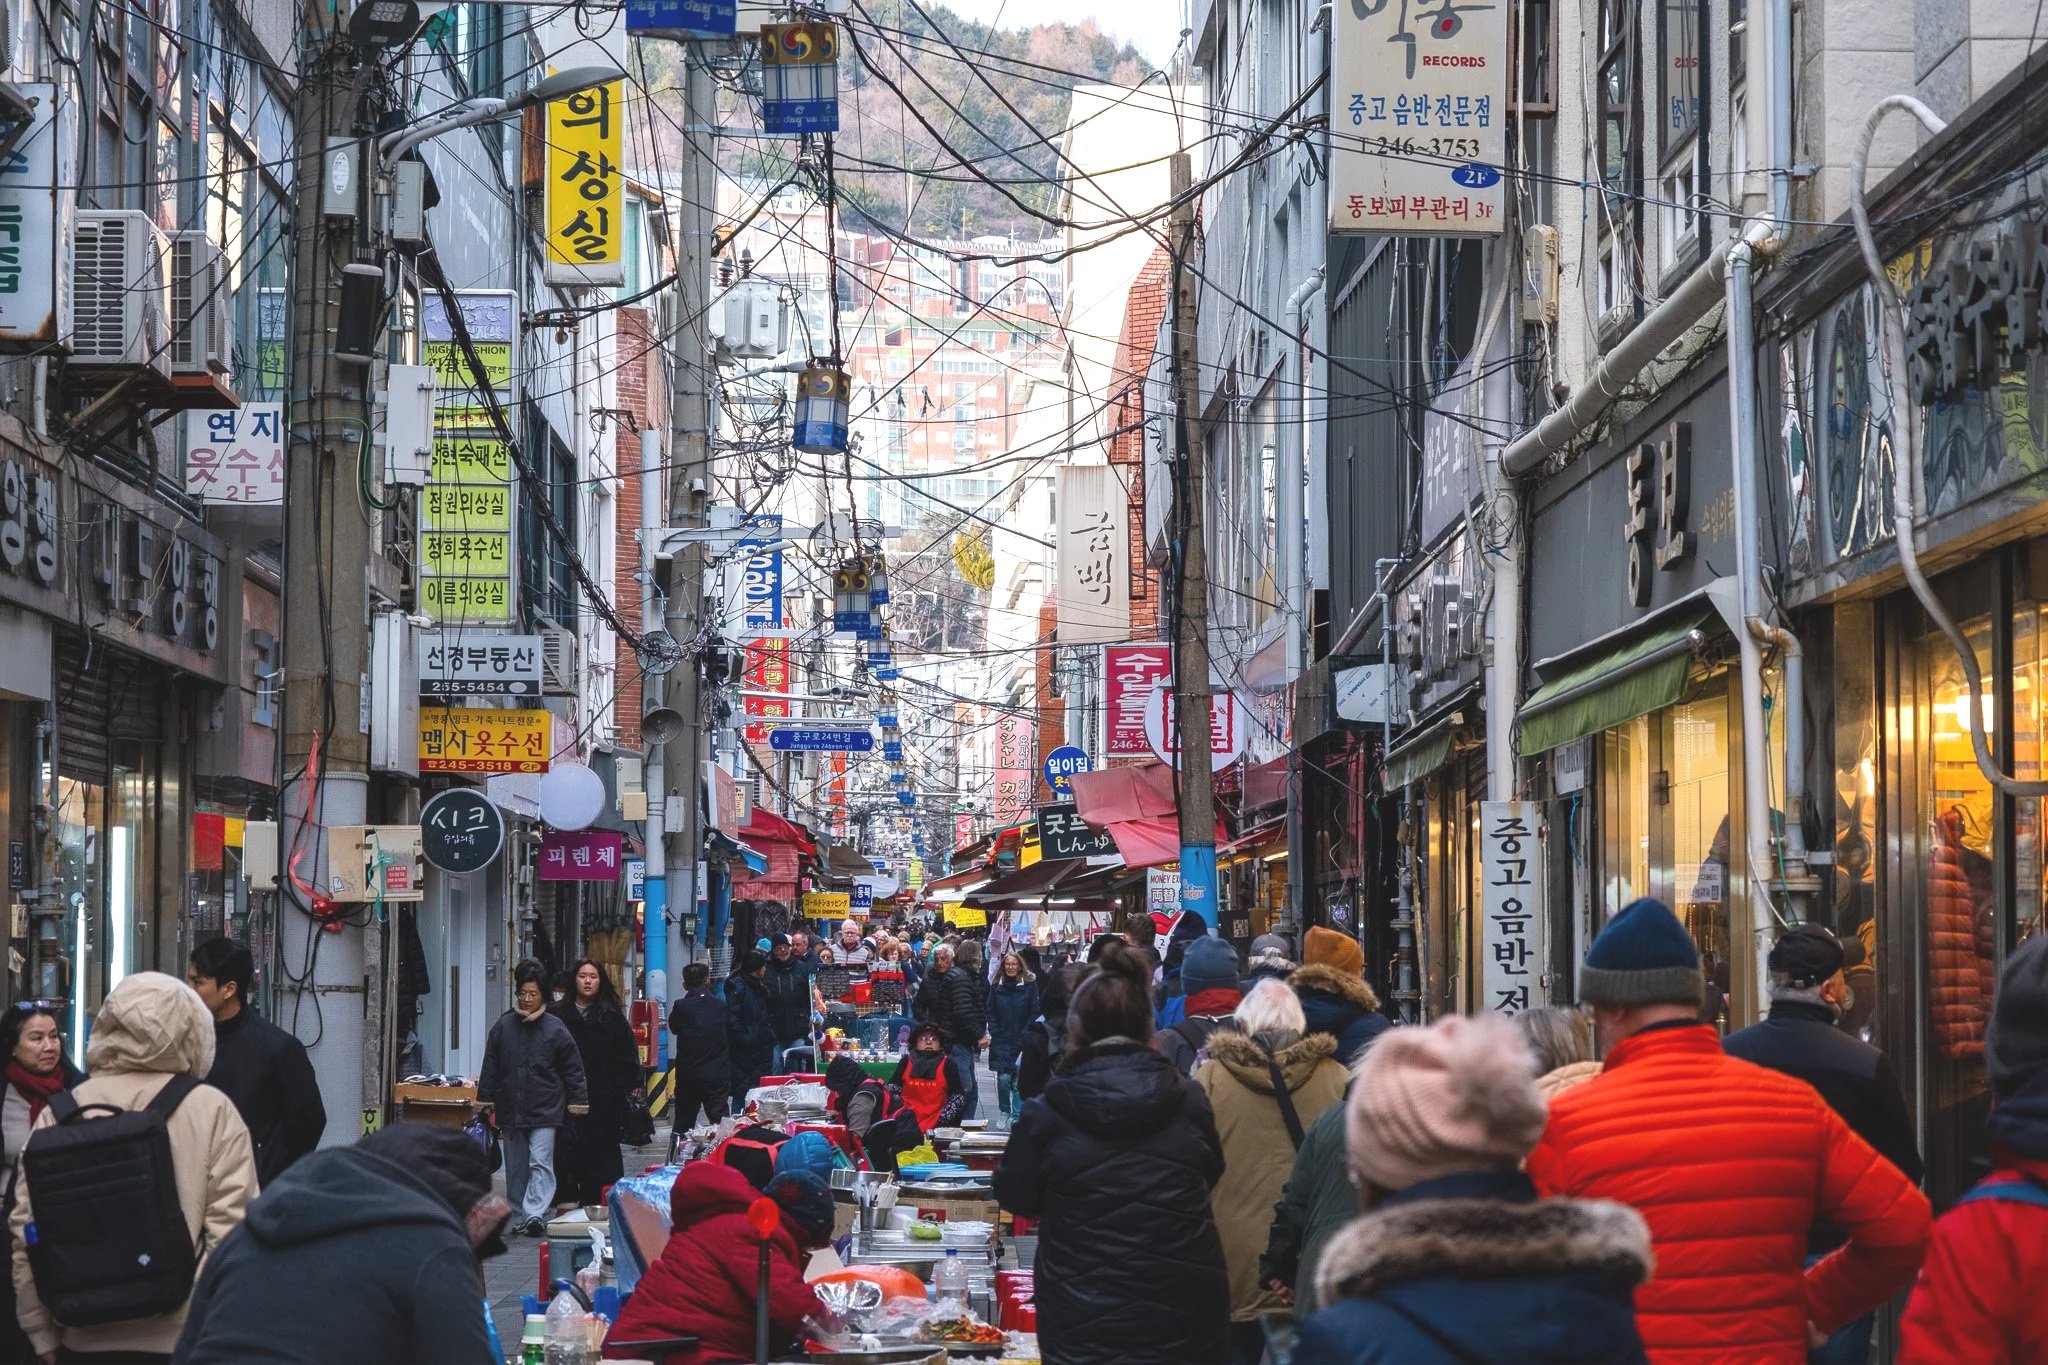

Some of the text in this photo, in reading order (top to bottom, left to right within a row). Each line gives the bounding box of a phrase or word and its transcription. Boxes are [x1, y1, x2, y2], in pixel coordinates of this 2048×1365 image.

[1422, 55, 1486, 68] RECORDS
[561, 84, 617, 260] 의상실
[1463, 170, 1489, 185] 2F
[1475, 201, 1495, 219] 3F
[207, 410, 279, 443] 연지
[226, 485, 258, 501] 2F
[427, 536, 504, 561] 정희옷수선
[427, 580, 504, 605] 아름의상실
[427, 646, 534, 673] 선경부동산
[792, 732, 851, 742] 중구로24번길
[440, 760, 540, 772] 245-3518 2F
[1000, 719, 1016, 820] オシャレ カバン
[1048, 757, 1088, 774] 일이집
[430, 806, 489, 833] 시크
[547, 845, 614, 868] 피렌체
[1151, 875, 1171, 883] MONEY
[1151, 888, 1175, 902] 両替
